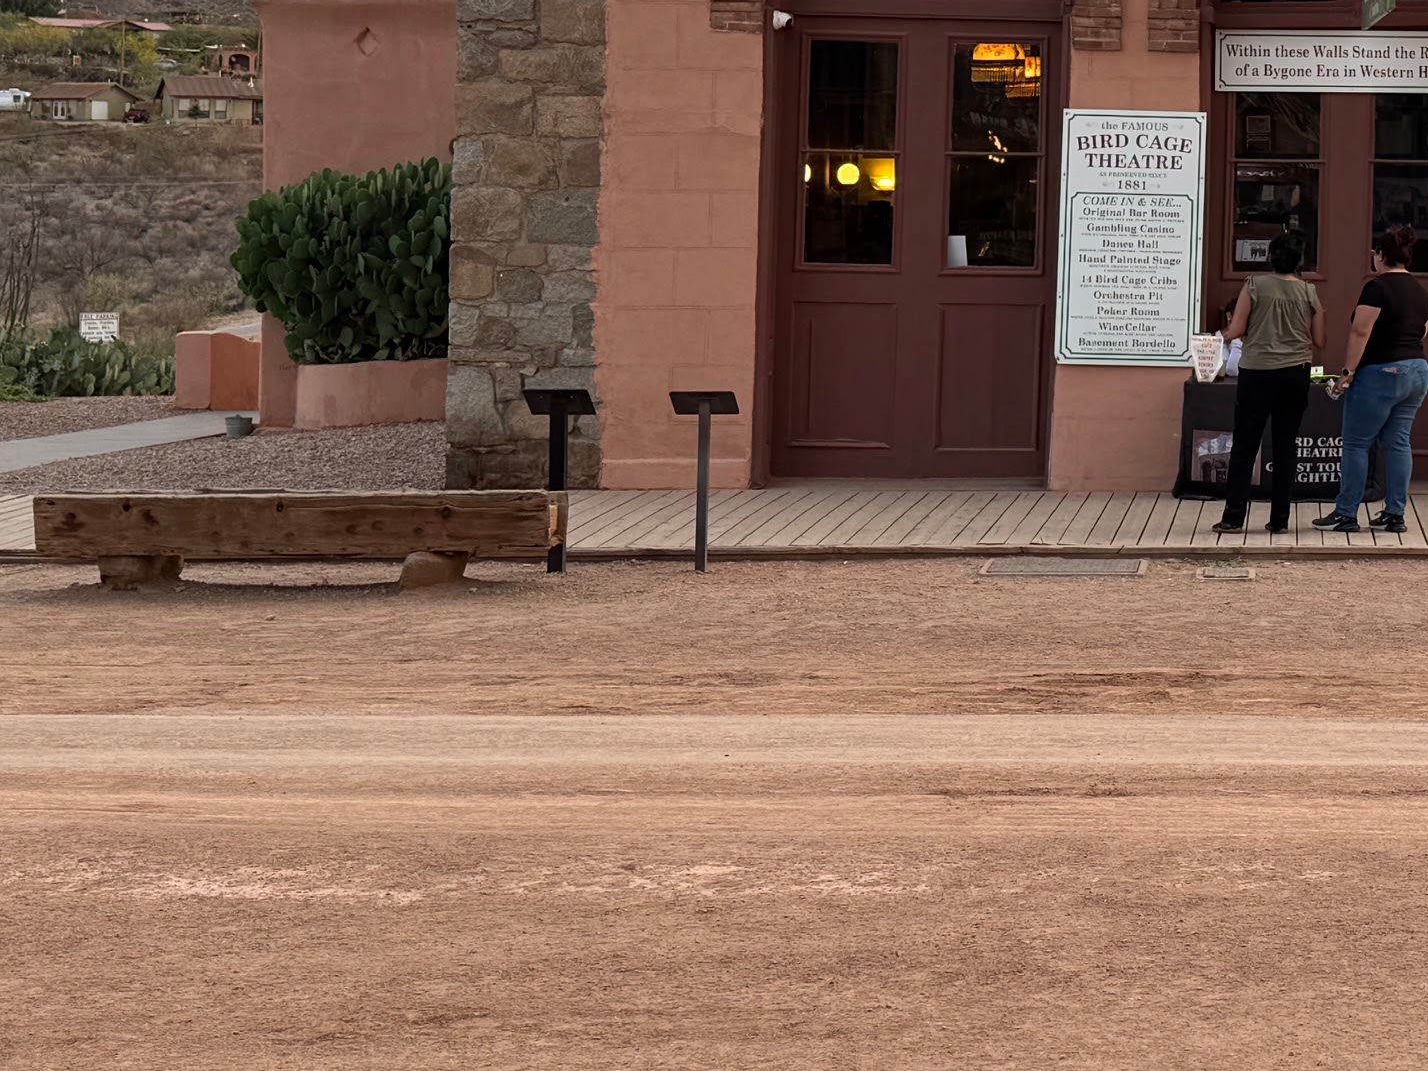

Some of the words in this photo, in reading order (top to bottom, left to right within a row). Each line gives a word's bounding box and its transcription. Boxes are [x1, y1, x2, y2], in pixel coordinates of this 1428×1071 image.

[1226, 44, 1270, 57] Within
[1275, 45, 1309, 58] these
[1313, 46, 1348, 58] Walls
[1352, 46, 1390, 59] Stand
[1395, 47, 1416, 59] the
[1236, 64, 1249, 76] of
[1252, 68, 1259, 76] a
[1264, 65, 1311, 79] Bygone
[1317, 65, 1339, 77] Era
[1344, 66, 1356, 77] in
[1361, 66, 1413, 78] Western
[1102, 121, 1118, 130] the
[1122, 122, 1168, 131] FAMOUS
[1077, 134, 1129, 150] BIRD
[1136, 134, 1192, 153] CAGE
[1085, 153, 1182, 169] THEATRE
[1118, 180, 1147, 190] 1881
[1083, 196, 1118, 206] COME
[1121, 197, 1134, 206] IN
[1138, 198, 1147, 206] &
[1083, 208, 1125, 217] Original
[1130, 209, 1147, 217] Bar
[1151, 209, 1180, 218] Room
[1087, 223, 1137, 234] Gambling
[1140, 224, 1174, 234] Casino
[1102, 239, 1133, 248] Dance
[1138, 240, 1158, 249] Hall
[1079, 254, 1106, 263] Hand
[1110, 255, 1149, 264] Painted
[1152, 256, 1181, 266] Stage
[1082, 275, 1092, 283] 14
[1096, 275, 1118, 284] Bird
[1122, 276, 1146, 285] Cage
[1094, 291, 1144, 300] Orchestra
[1149, 292, 1163, 300] Pit
[1097, 306, 1127, 316] Poker
[1131, 307, 1160, 316] Room
[1079, 338, 1128, 347] Basement
[1132, 339, 1176, 348] Bordello
[1295, 437, 1314, 446] RD
[1317, 437, 1343, 446] CAG
[1265, 462, 1313, 472] GST
